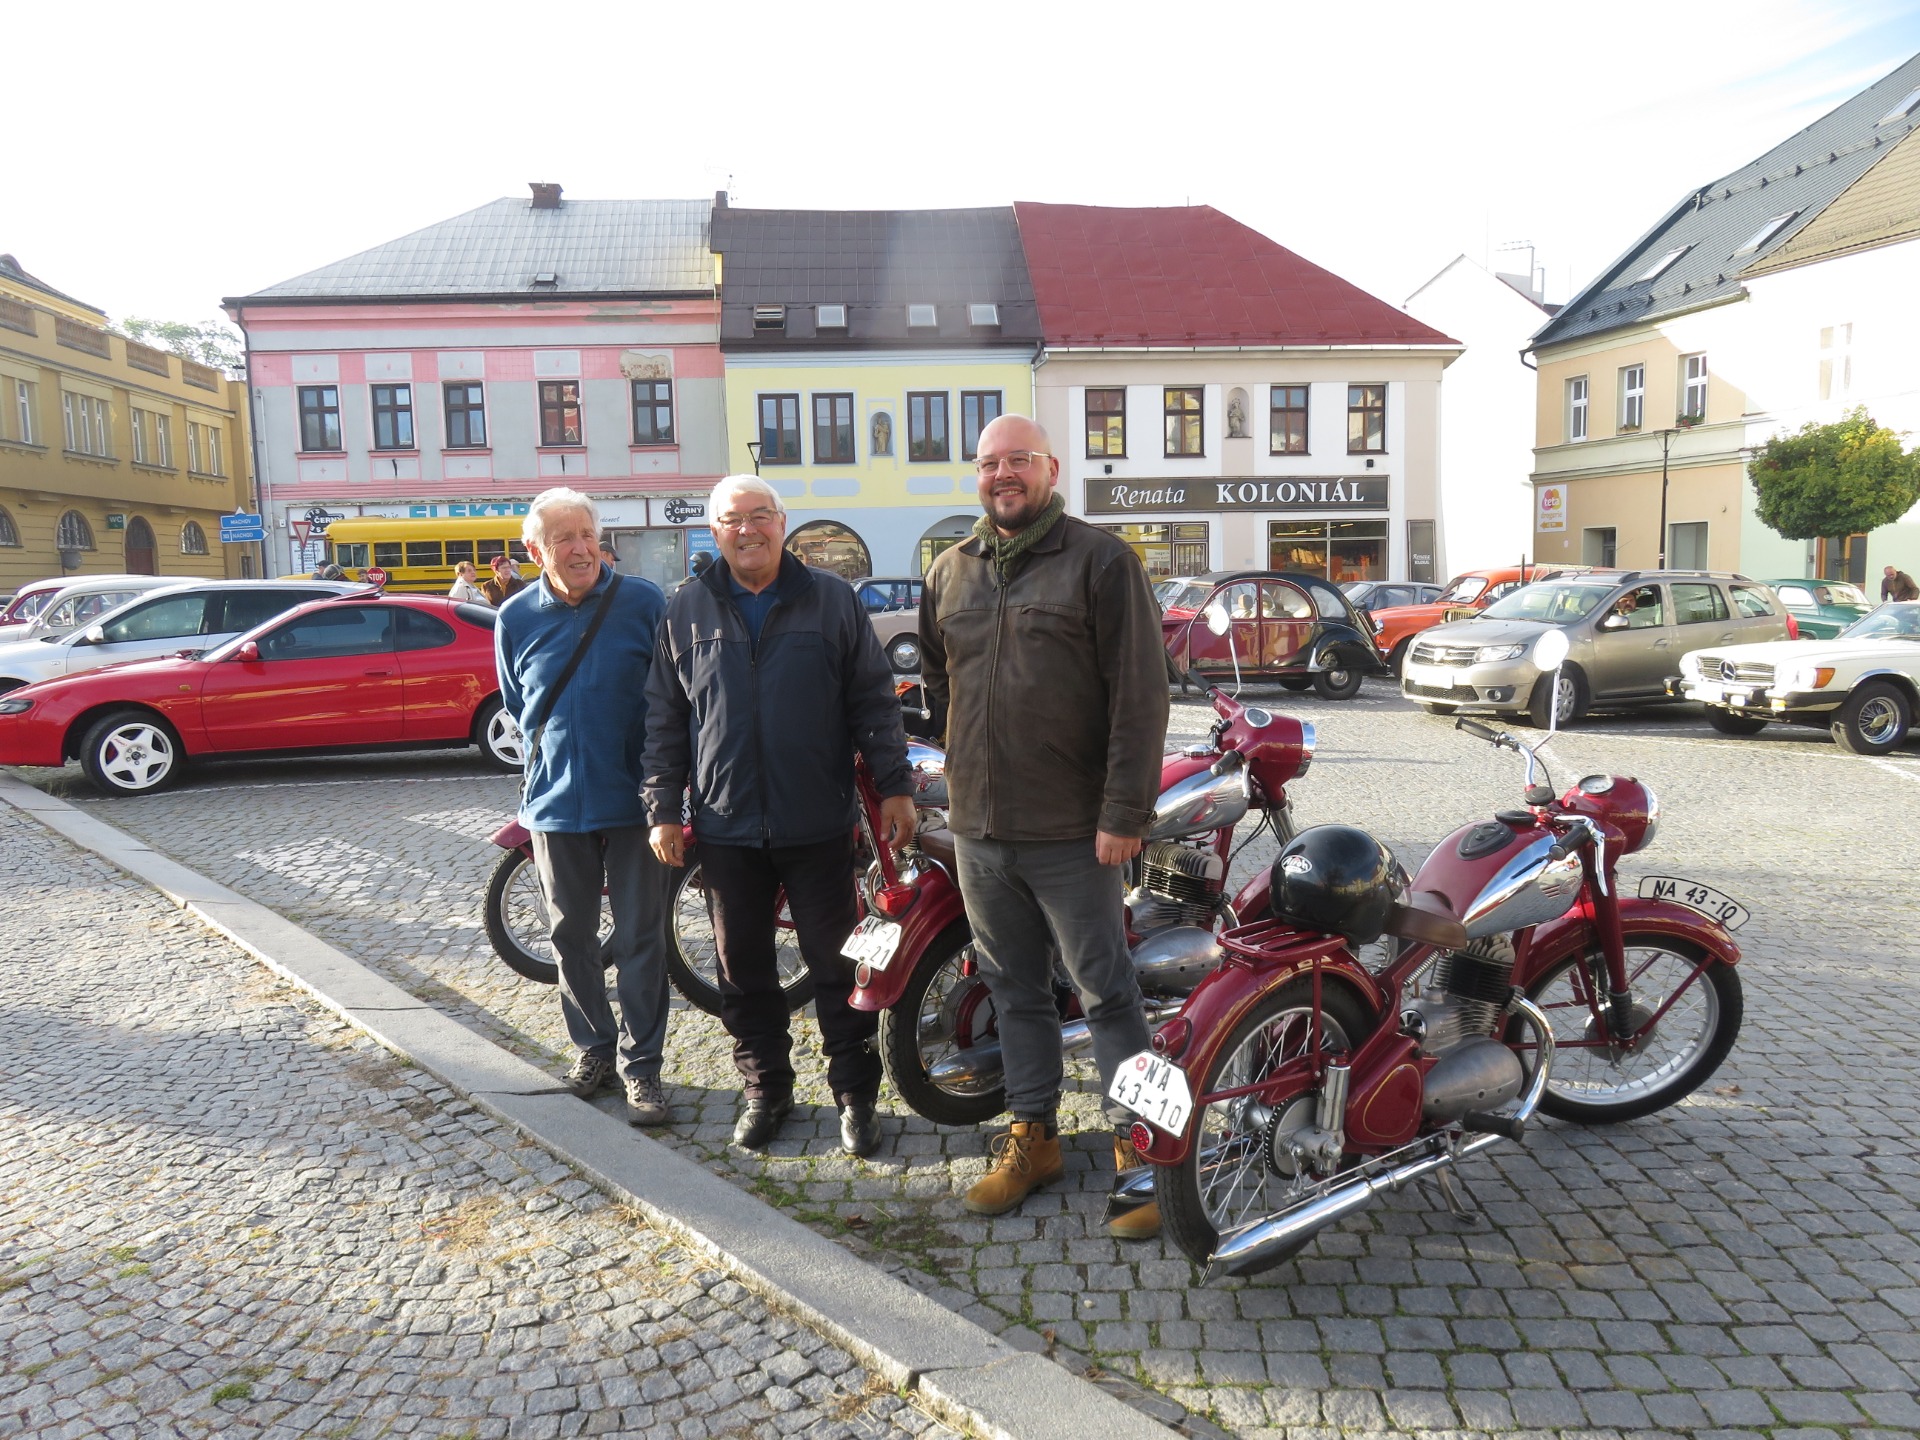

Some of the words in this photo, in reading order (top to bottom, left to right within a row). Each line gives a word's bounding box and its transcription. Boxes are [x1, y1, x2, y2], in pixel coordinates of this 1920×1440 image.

[1110, 485, 1186, 508] Renata
[1216, 477, 1365, 504] KOLONIÁL
[1544, 497, 1560, 507] teta
[665, 499, 682, 523] SERVIS
[368, 573, 384, 581] STOP
[1653, 880, 1676, 898] NA
[1685, 886, 1738, 920] 43-10
[847, 936, 891, 966] 07-21
[1144, 1060, 1172, 1092] NA
[1117, 1075, 1182, 1129] 43-10
